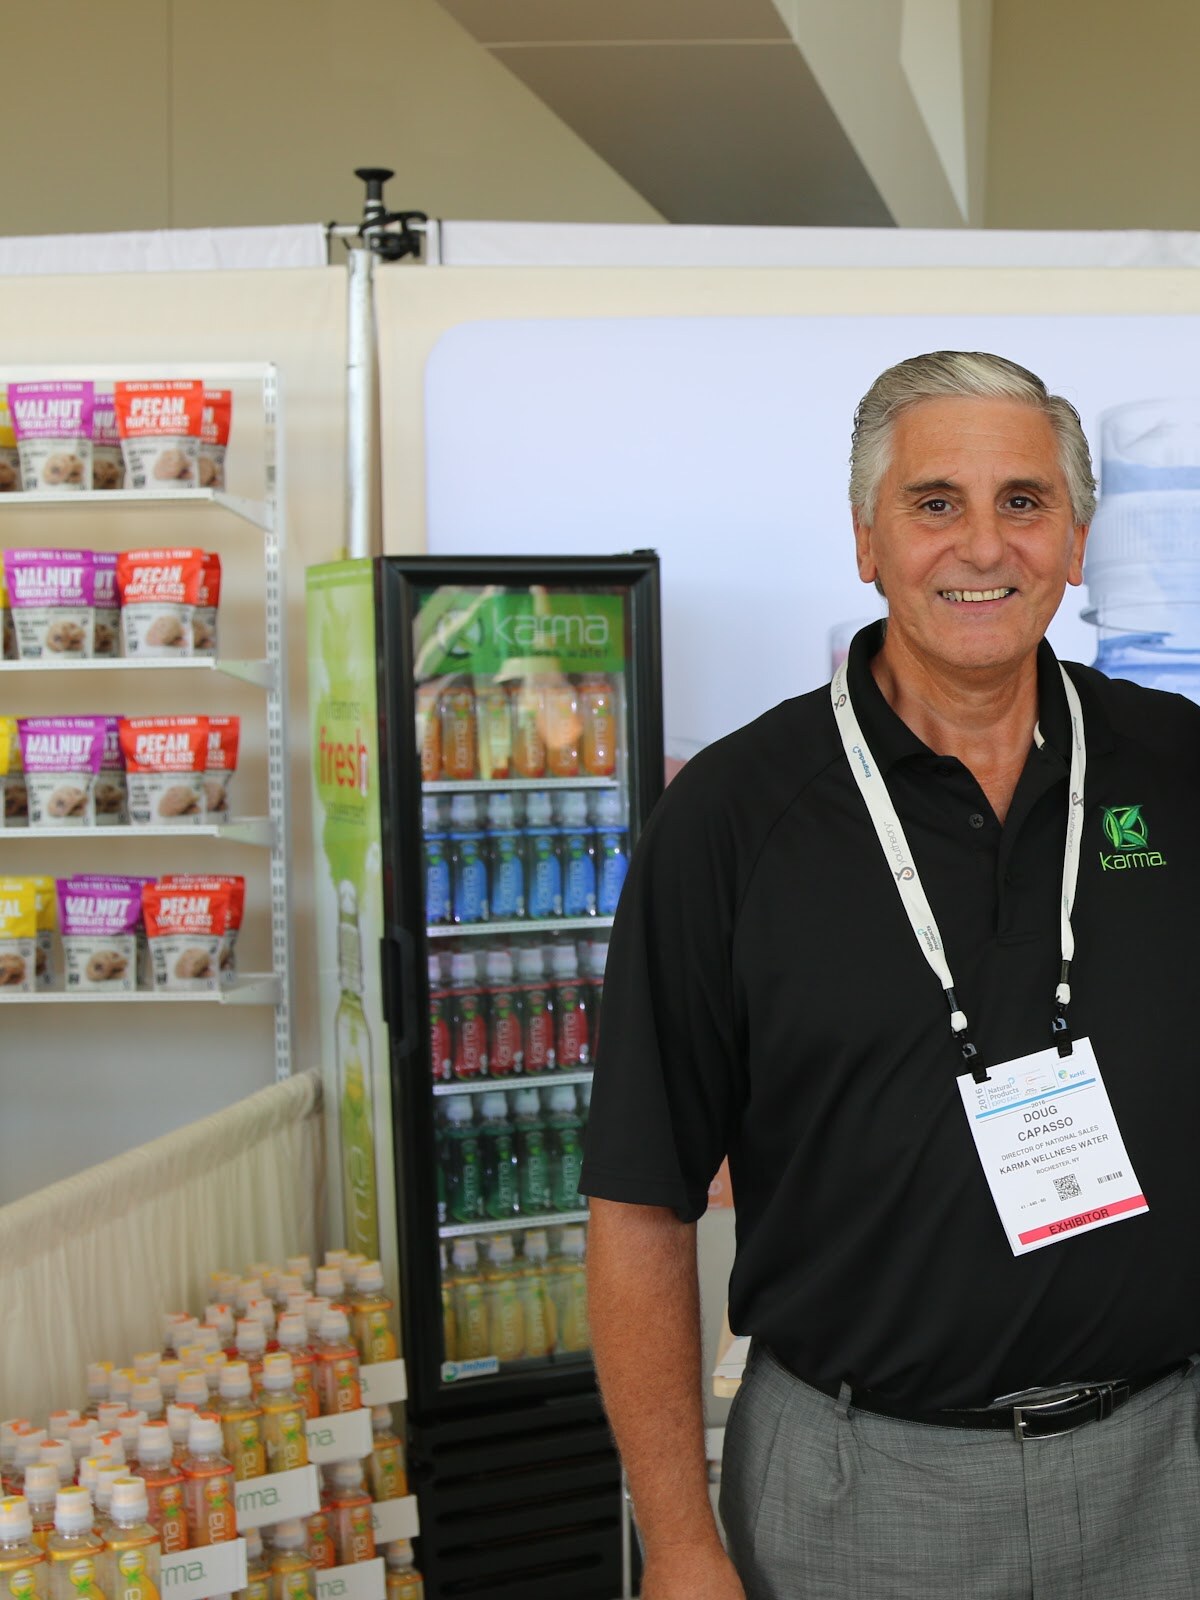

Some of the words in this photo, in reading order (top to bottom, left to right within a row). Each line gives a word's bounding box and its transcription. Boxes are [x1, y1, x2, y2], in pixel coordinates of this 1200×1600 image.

[14, 399, 83, 419] WALNUT
[131, 397, 186, 417] PECAN
[14, 567, 84, 588] WALNUT
[132, 565, 182, 585] PECAN
[492, 606, 609, 645] karma
[26, 735, 95, 754] WALNUT
[136, 733, 190, 752] PECAN
[319, 725, 369, 790] fresh
[65, 896, 131, 916] WALNUT
[160, 897, 210, 914] PECAN
[923, 931, 935, 952] Natural
[927, 925, 939, 950] Products
[987, 1083, 1012, 1094] Natural
[989, 1088, 1019, 1100] Products
[976, 1088, 988, 1110] 2016
[992, 1098, 1006, 1107] EXPO
[1031, 1100, 1046, 1108] 2016
[1023, 1105, 1058, 1123] DOUG
[1017, 1117, 1073, 1141] CAPASSO
[1001, 1146, 1034, 1161] DIRECTOR
[1045, 1133, 1077, 1147] NATIONAL
[1078, 1125, 1099, 1136] SALES
[999, 1160, 1030, 1175] KARMA
[1032, 1144, 1077, 1164] WELLNESS
[1079, 1134, 1109, 1149] WATER
[1049, 1208, 1110, 1235] EXHIBITOR
